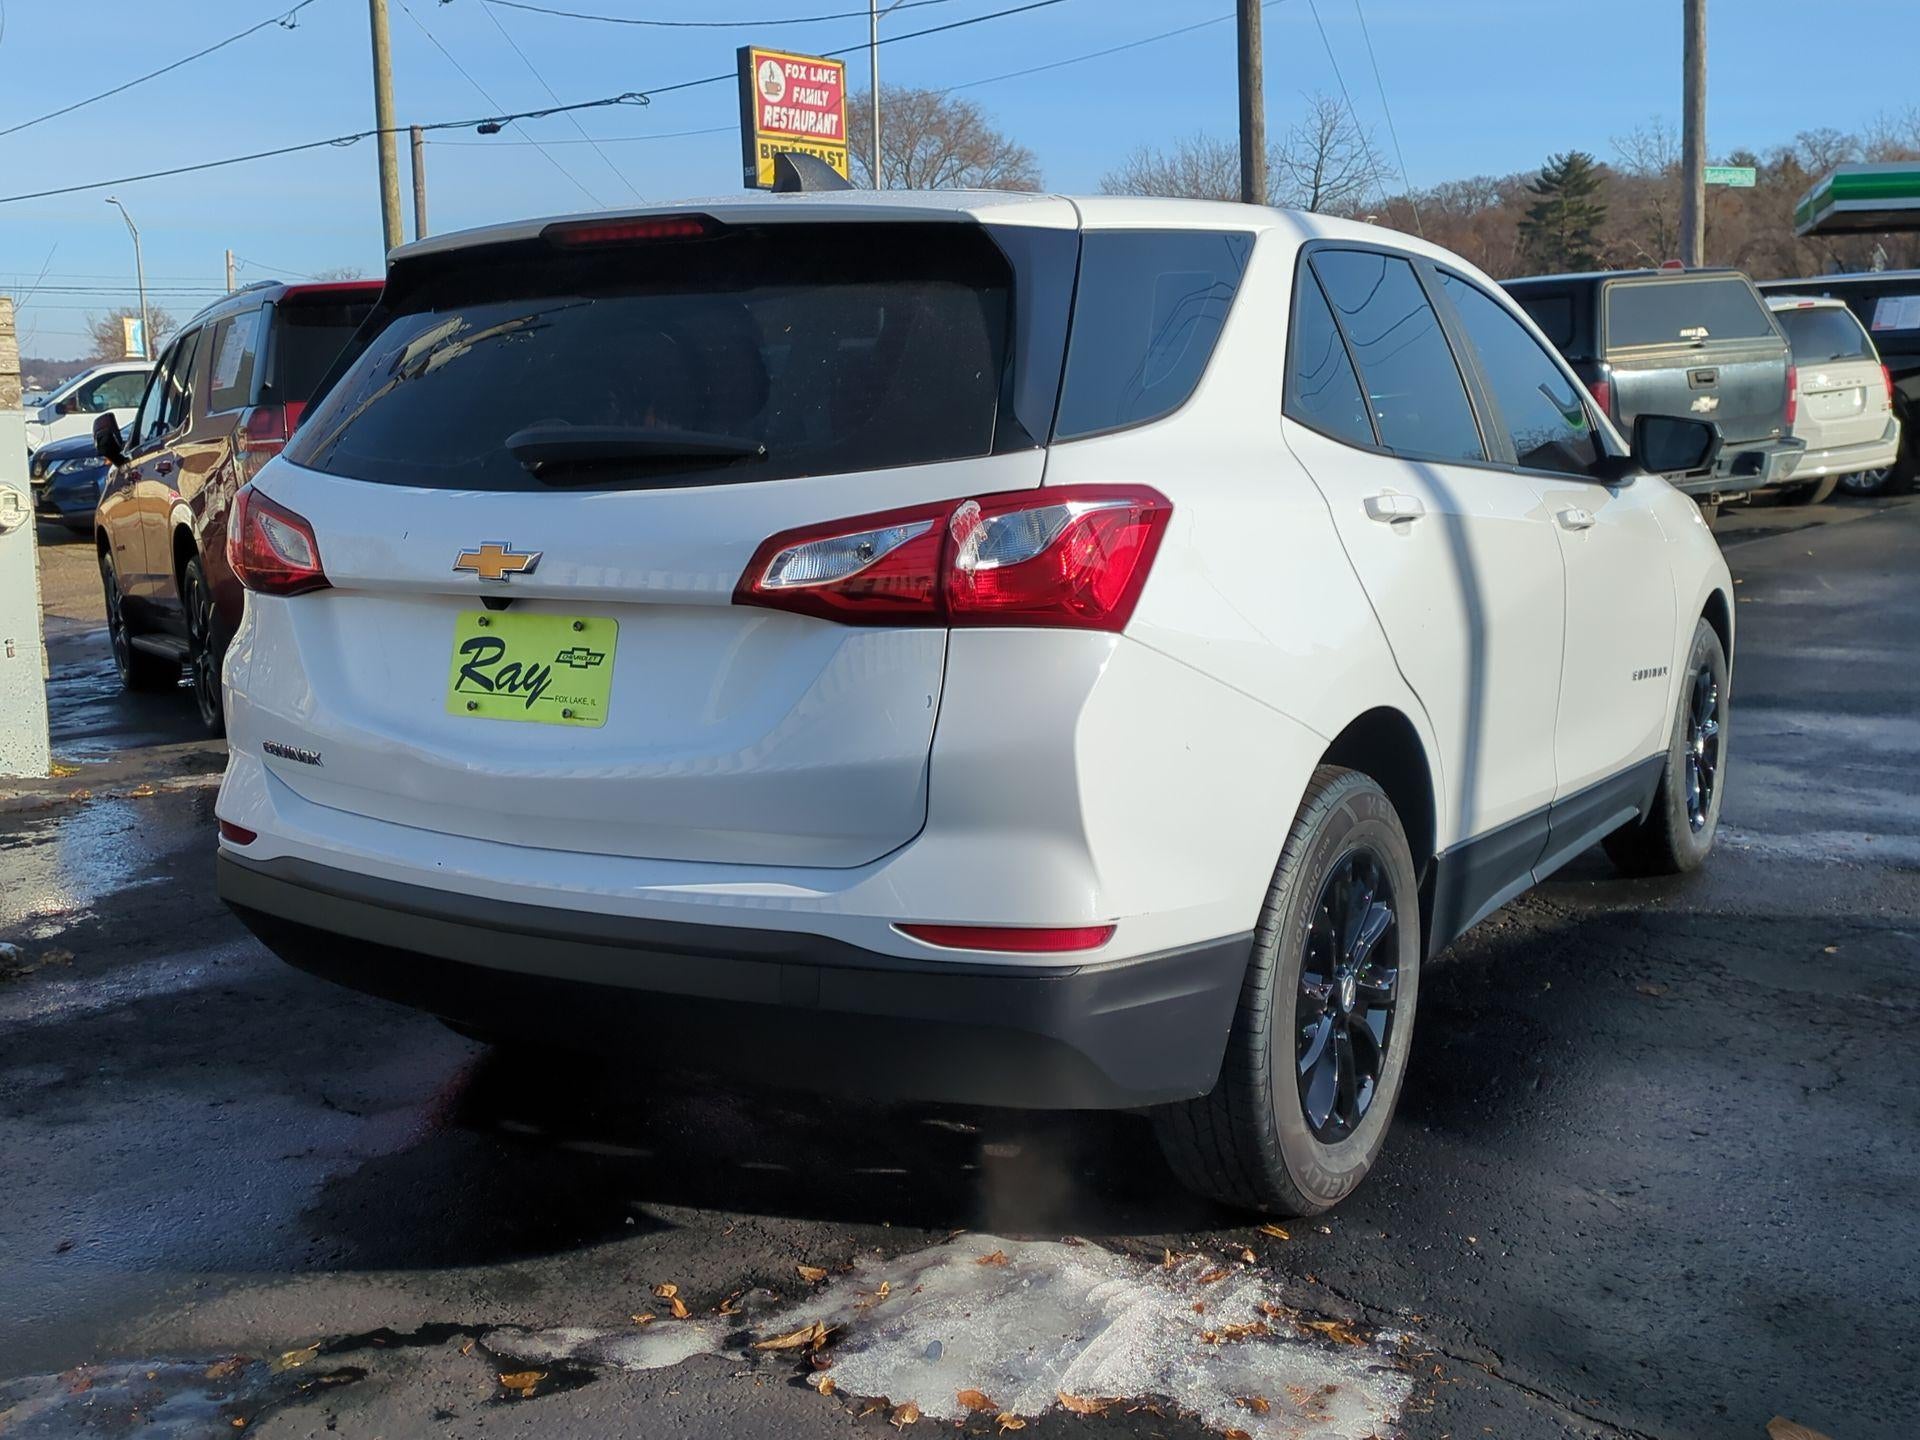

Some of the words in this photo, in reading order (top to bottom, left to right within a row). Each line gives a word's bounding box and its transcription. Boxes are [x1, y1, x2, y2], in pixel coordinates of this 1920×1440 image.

[785, 63, 807, 80] FOX
[810, 67, 837, 84] LAKE
[793, 86, 829, 107] FAMILY
[763, 105, 838, 135] RESTAURANT
[454, 636, 553, 709] Ray
[555, 695, 568, 703] FOX
[1292, 863, 1322, 957] TOURING
[1300, 1161, 1354, 1198] KELLY
